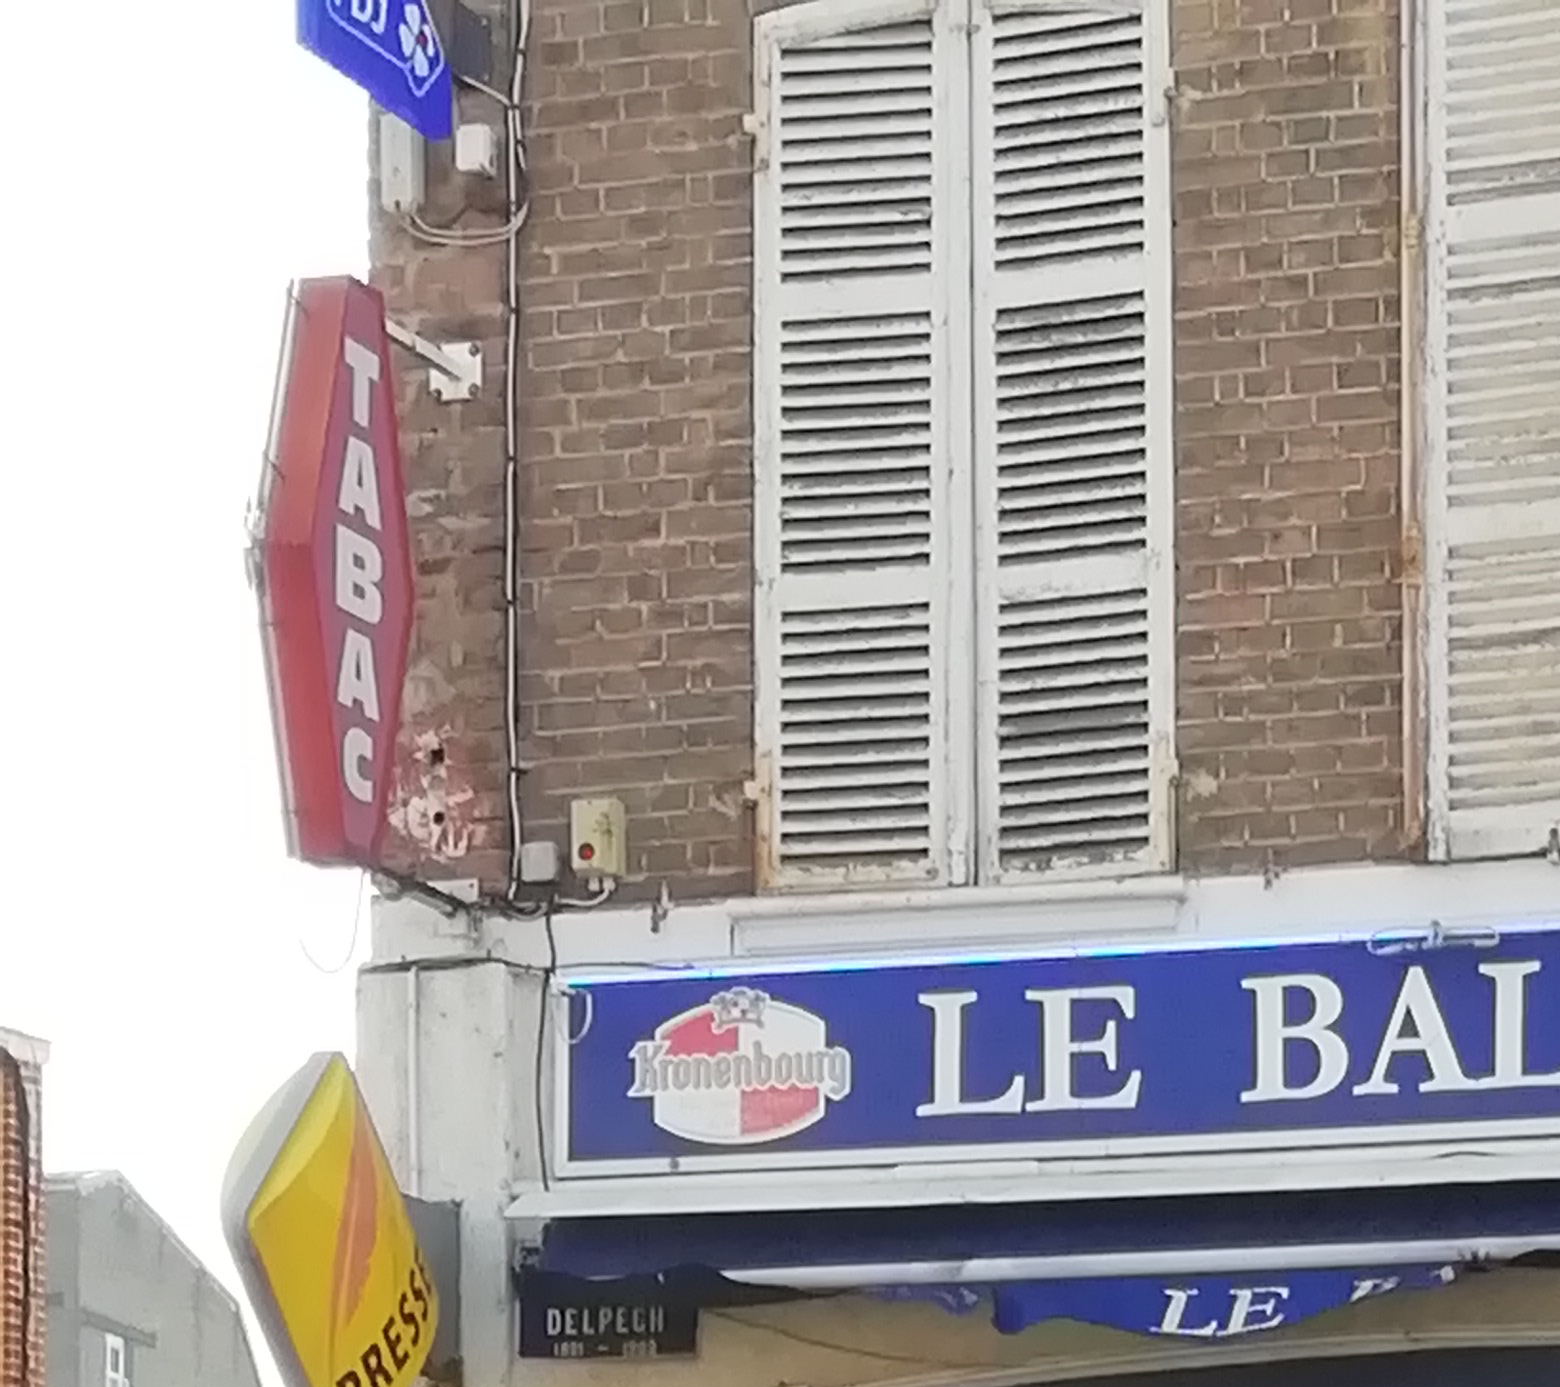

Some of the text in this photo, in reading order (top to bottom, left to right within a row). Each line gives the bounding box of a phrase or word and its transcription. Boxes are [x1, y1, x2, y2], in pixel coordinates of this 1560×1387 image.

[334, 336, 383, 802] TABAC
[631, 1038, 849, 1097] Kronenbourg
[917, 986, 1141, 1116] LE
[546, 1304, 665, 1336] DELPECH
[1151, 1286, 1290, 1338] LE
